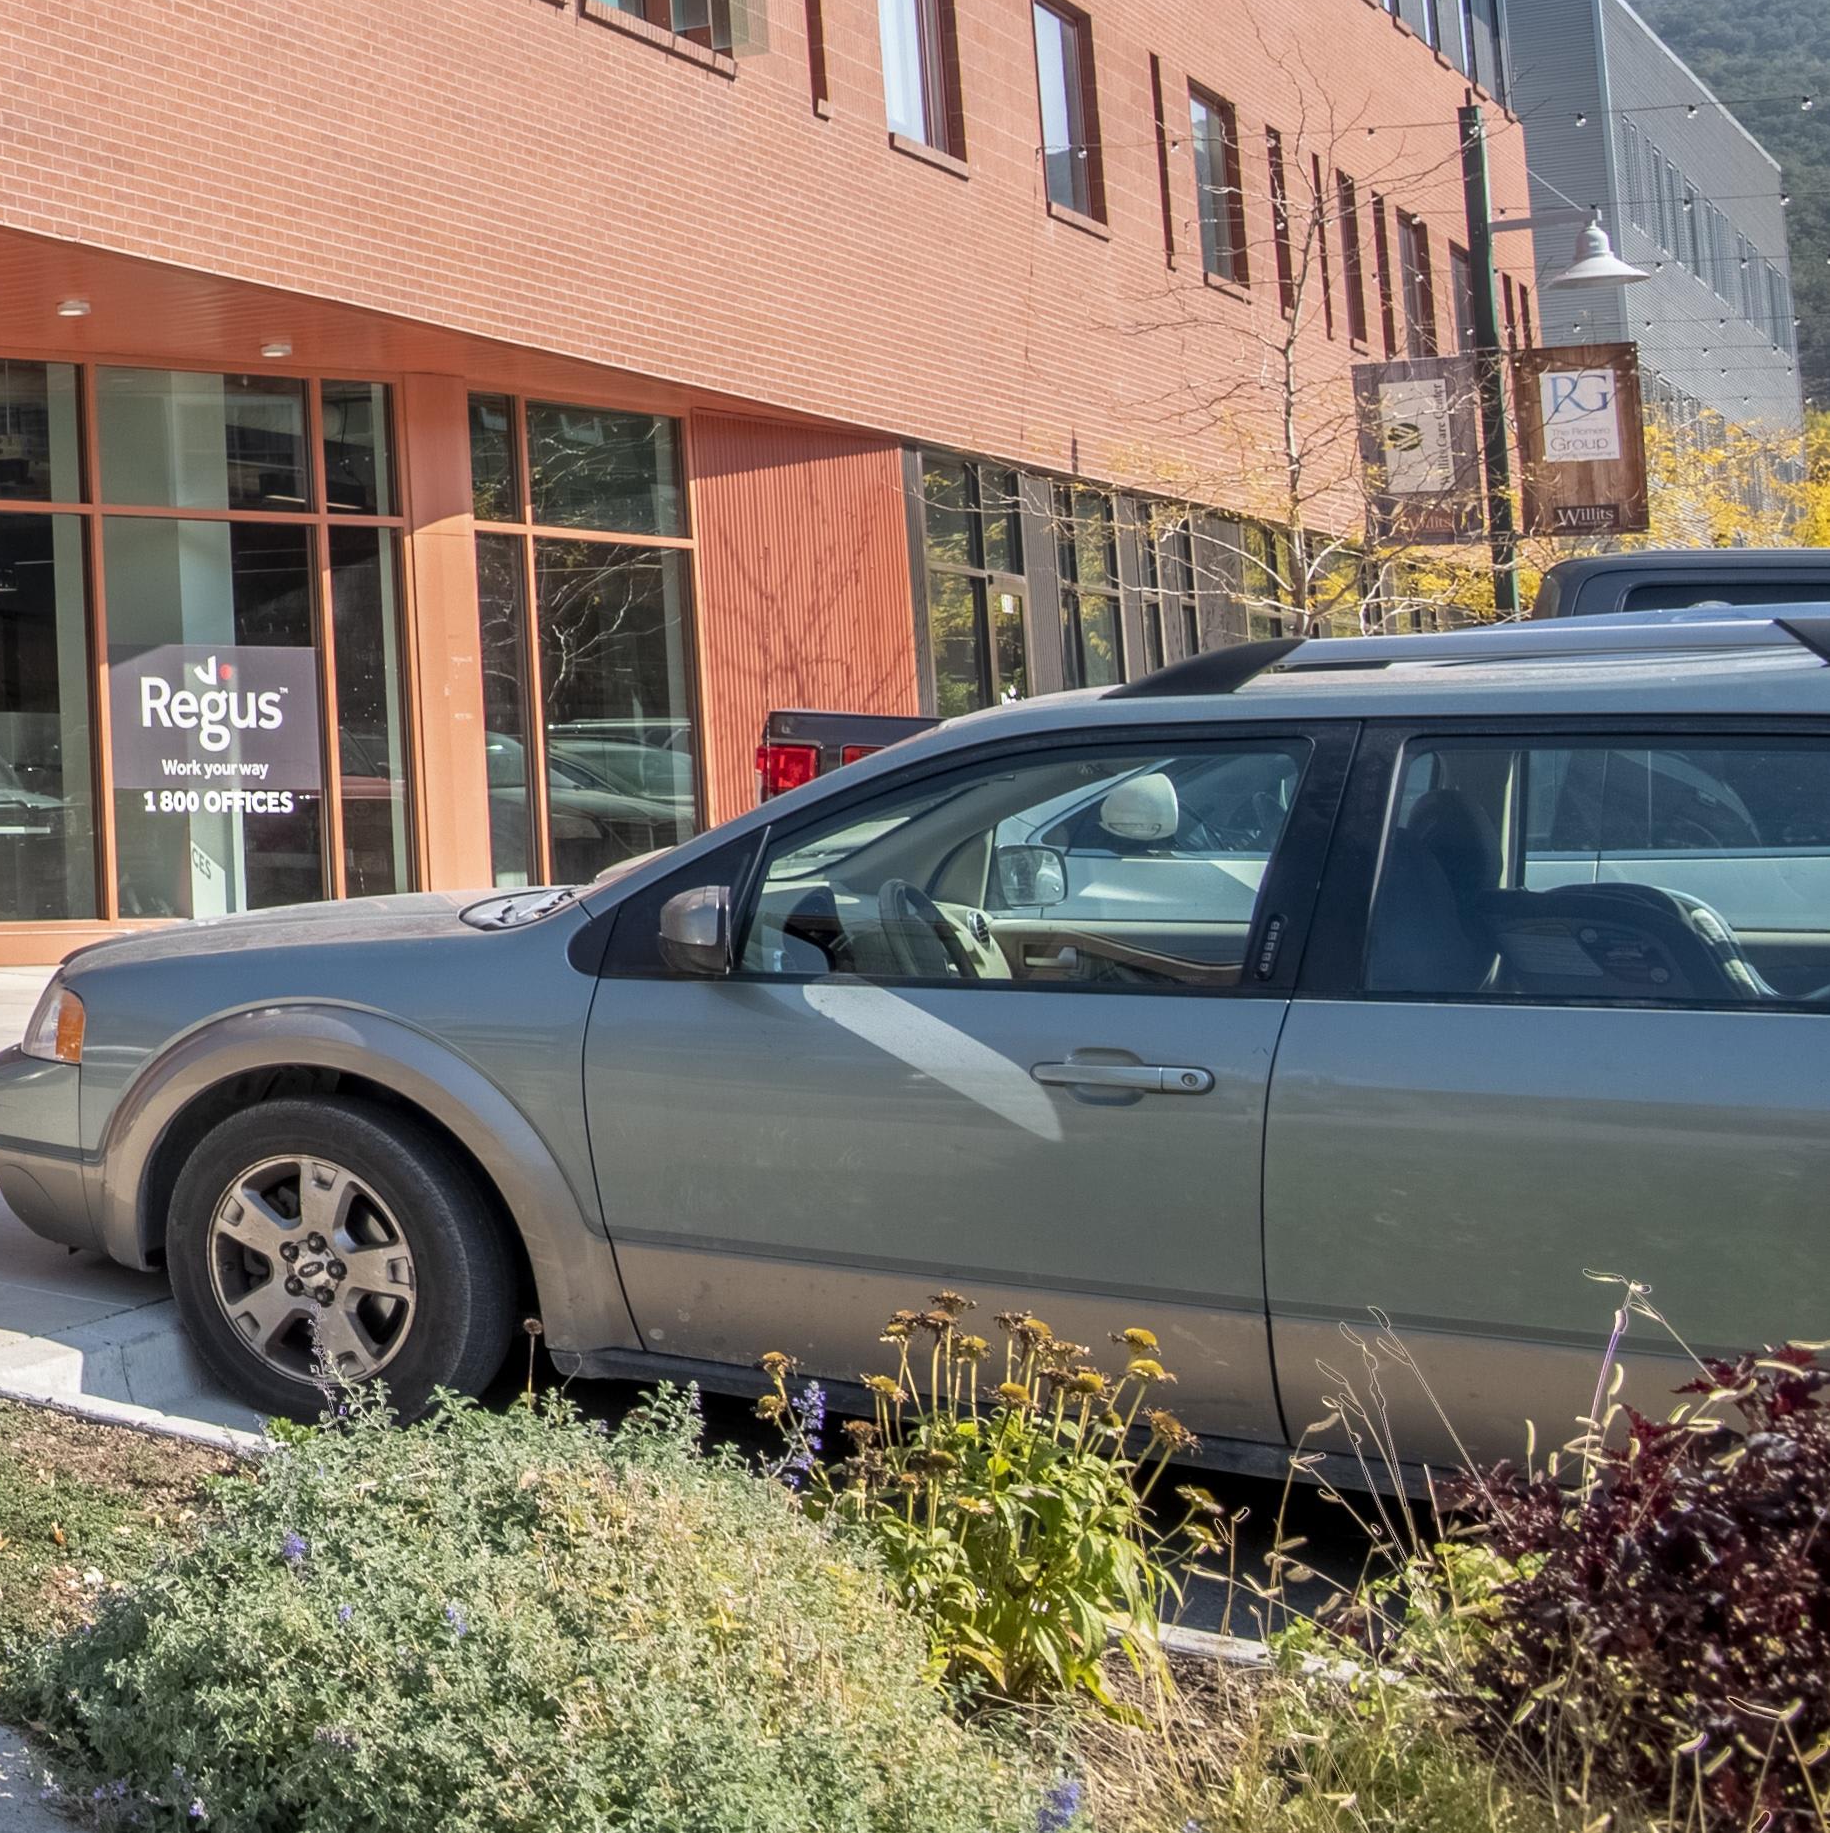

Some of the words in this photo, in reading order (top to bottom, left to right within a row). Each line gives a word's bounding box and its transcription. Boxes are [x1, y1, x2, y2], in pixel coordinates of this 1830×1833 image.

[1550, 437, 1609, 452] Group
[1556, 507, 1615, 527] Willits
[140, 676, 283, 752] Regus
[161, 759, 201, 776] Work
[204, 762, 238, 780] your
[238, 763, 269, 780] way
[143, 791, 156, 813] 1
[159, 790, 200, 813] 800
[203, 790, 294, 814] OFFICES
